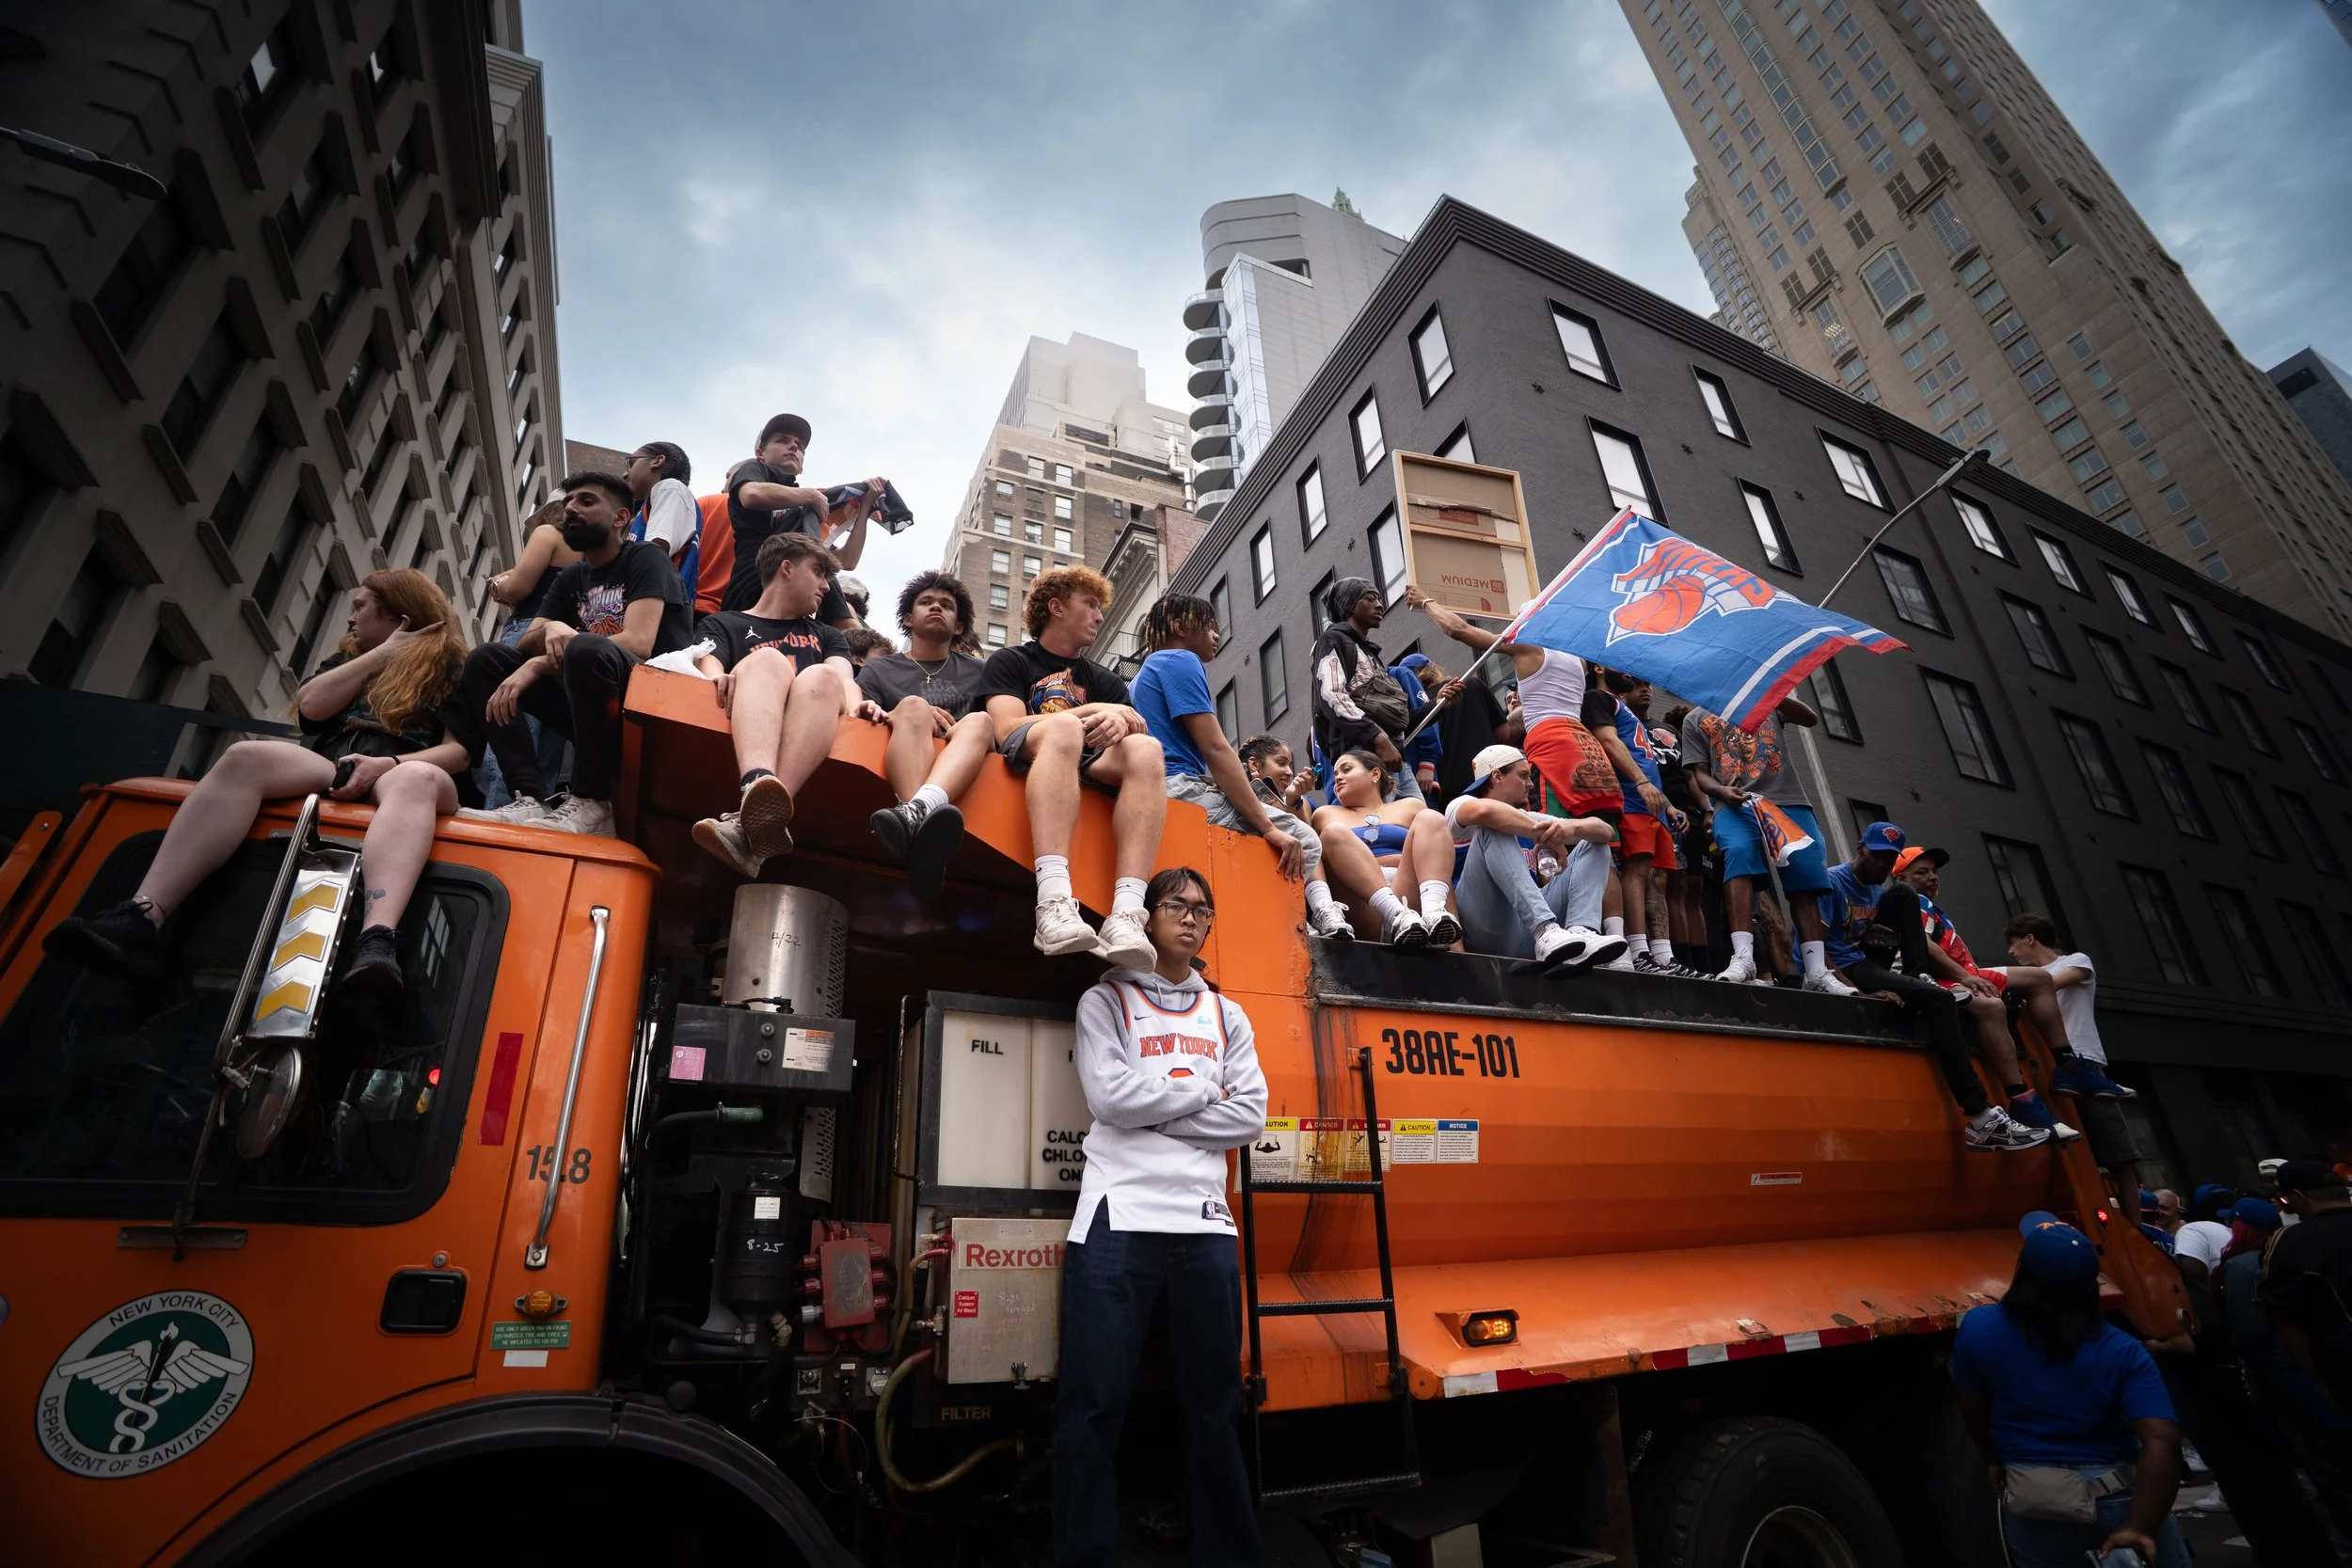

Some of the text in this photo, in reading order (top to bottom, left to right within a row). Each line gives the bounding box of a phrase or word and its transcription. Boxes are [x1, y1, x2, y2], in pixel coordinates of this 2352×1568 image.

[1441, 574, 1489, 589] MEDIUM
[971, 1039, 1004, 1055] FILL
[1139, 1033, 1217, 1063] NEW YORK
[1381, 1028, 1520, 1078] 38AE-101
[1047, 1131, 1089, 1144] CALC
[1042, 1148, 1088, 1163] CHLO
[1059, 1168, 1084, 1181] ON
[747, 1238, 785, 1253] 8-25
[965, 1243, 1065, 1268] Rexroth
[109, 1294, 240, 1329] NEW YORK CITY
[942, 1406, 991, 1420] FILTER
[42, 1392, 237, 1473] DEPARTMENT OF SANITATION
